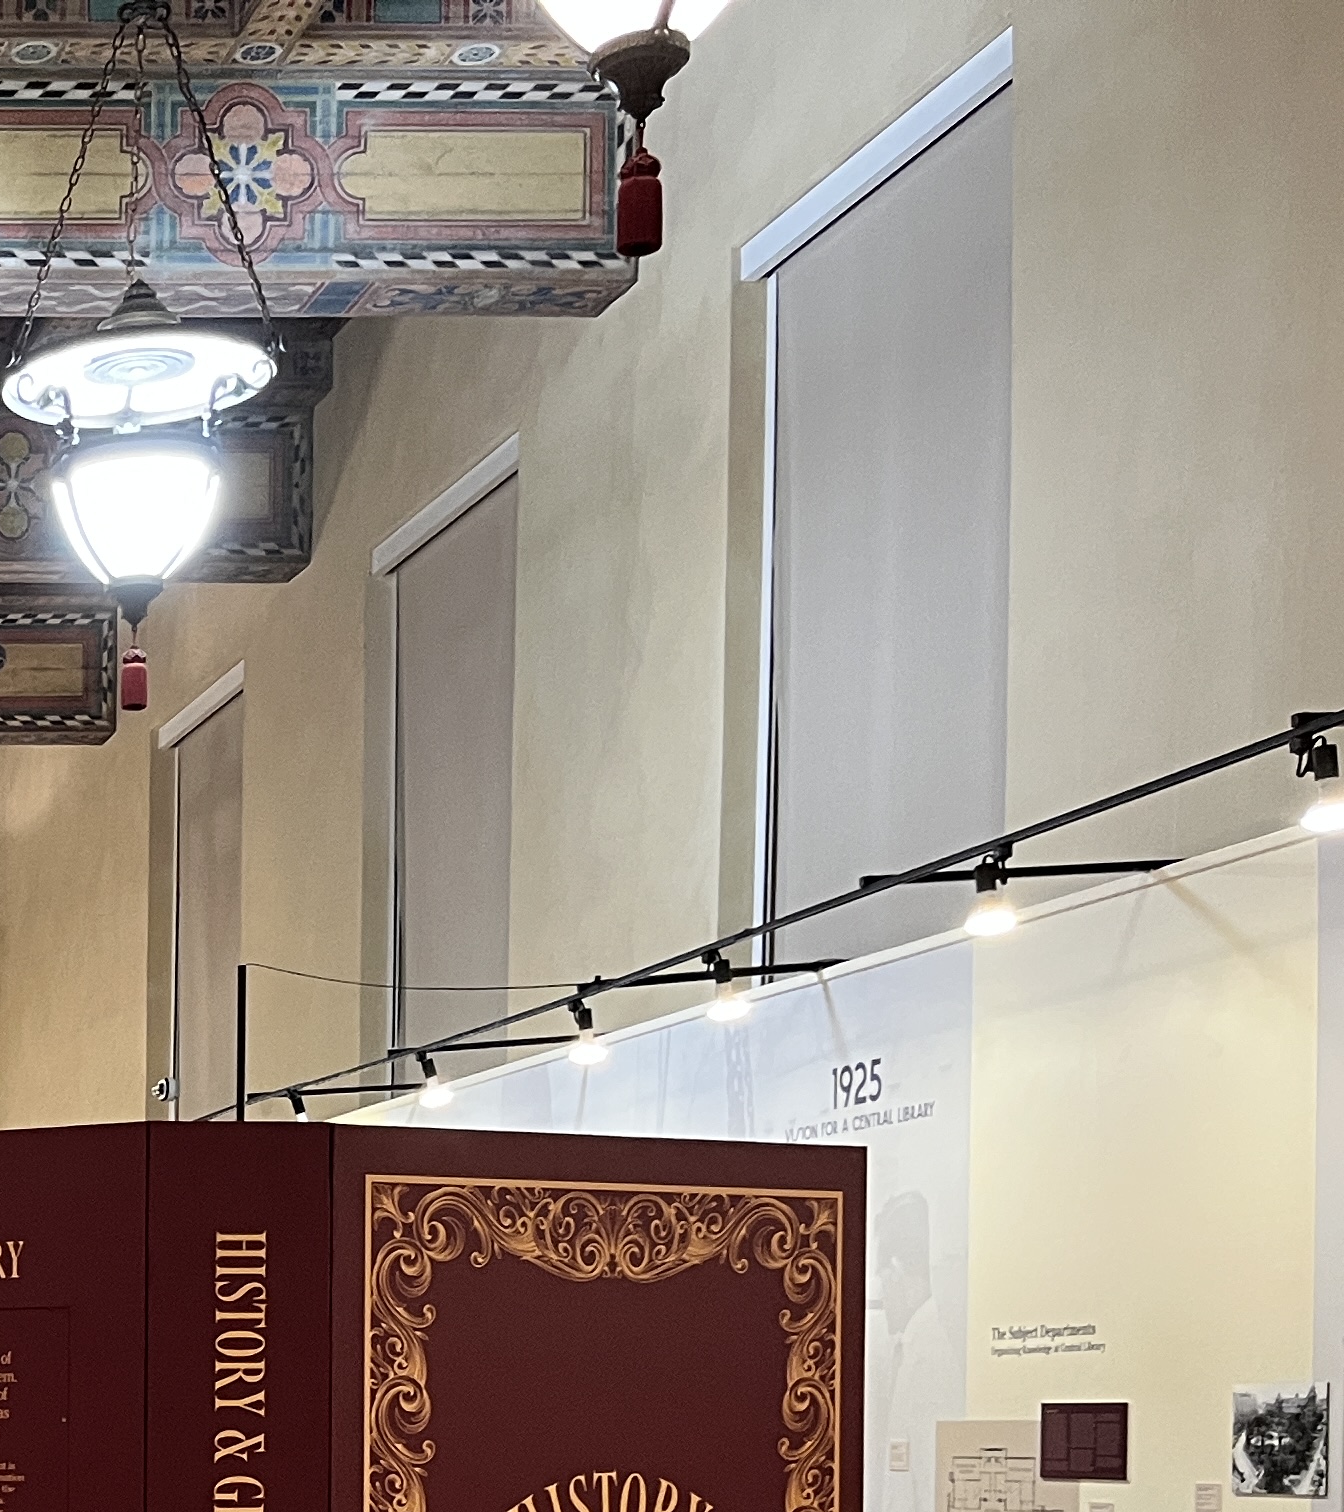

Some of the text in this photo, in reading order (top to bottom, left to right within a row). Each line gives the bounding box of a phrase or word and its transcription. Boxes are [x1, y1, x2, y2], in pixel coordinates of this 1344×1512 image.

[832, 1058, 882, 1110] 1925
[821, 1120, 838, 1136] FOR
[852, 1109, 893, 1131] CENTRAL
[897, 1100, 935, 1124] LIBRARY
[214, 1231, 267, 1417] HISTORY
[213, 1429, 266, 1464] &
